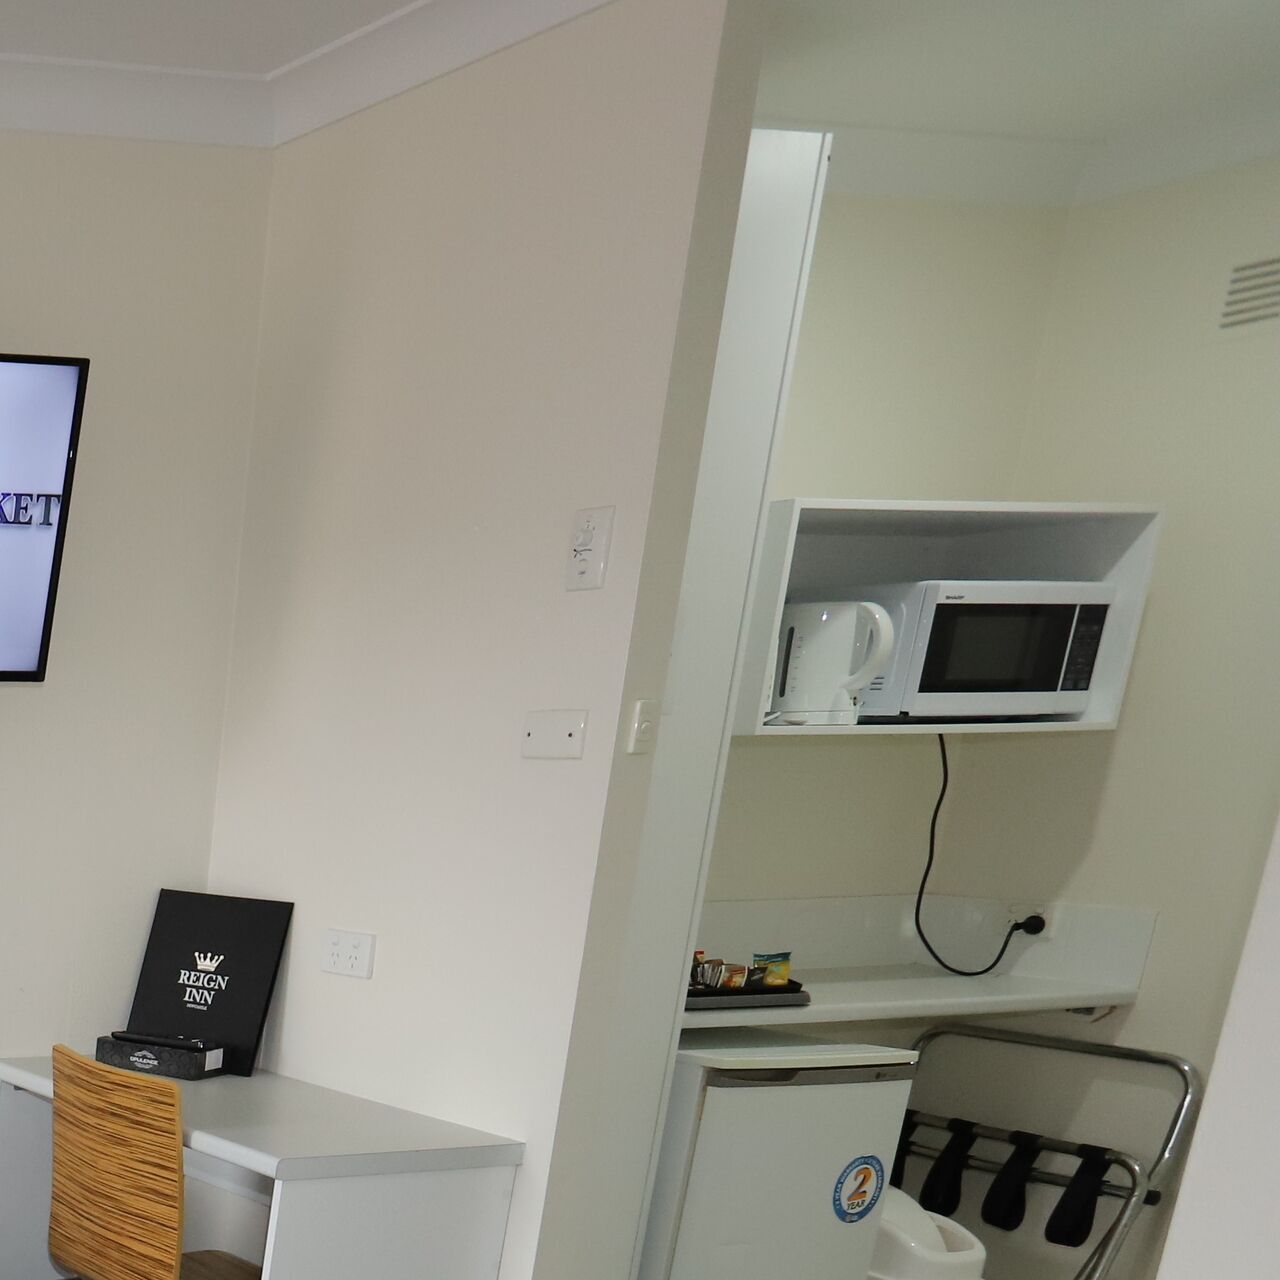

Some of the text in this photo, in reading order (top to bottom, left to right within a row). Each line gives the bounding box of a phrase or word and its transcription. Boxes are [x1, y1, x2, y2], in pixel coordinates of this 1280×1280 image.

[178, 970, 229, 990] REIGN
[183, 987, 216, 1005] INN
[847, 1167, 872, 1202] 2
[846, 1200, 866, 1211] YEAR
